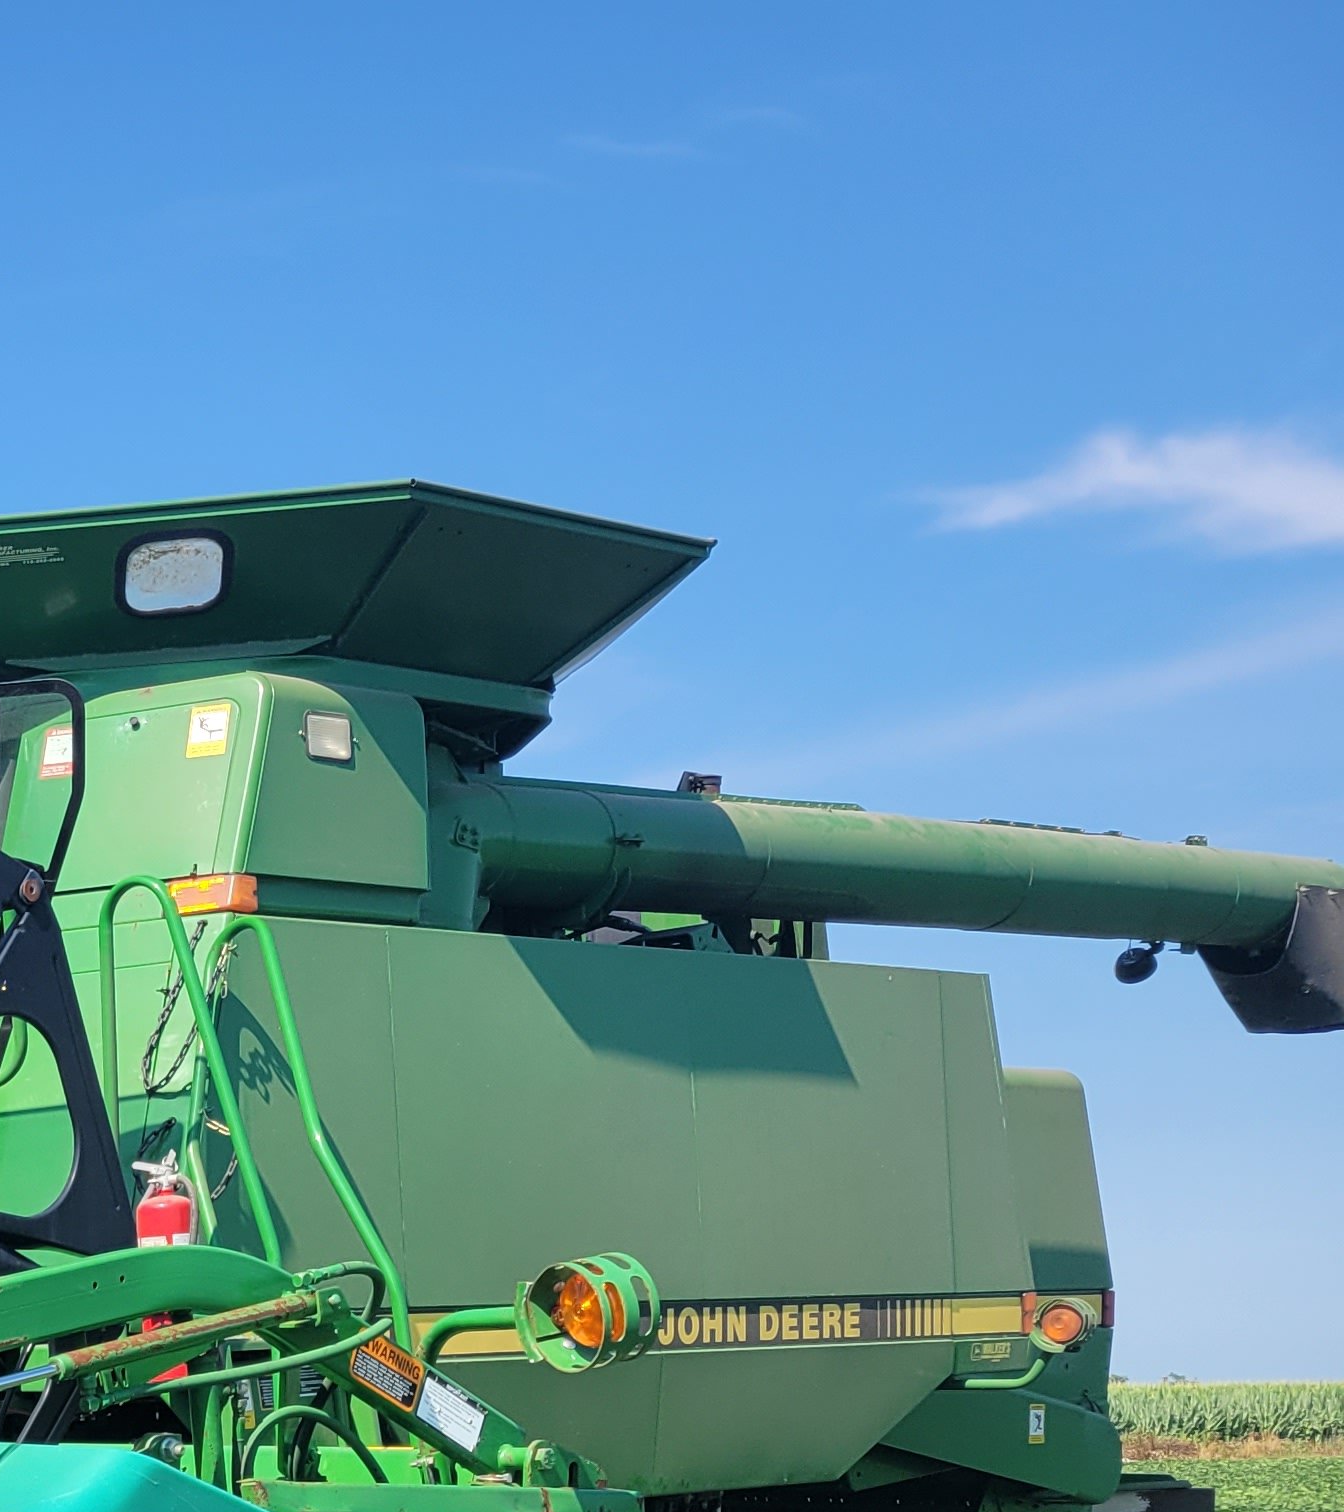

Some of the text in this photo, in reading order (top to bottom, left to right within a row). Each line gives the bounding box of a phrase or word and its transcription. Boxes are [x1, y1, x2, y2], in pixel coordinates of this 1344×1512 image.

[657, 1303, 861, 1346] JOHN DEERE
[371, 1339, 421, 1381] WARNING
